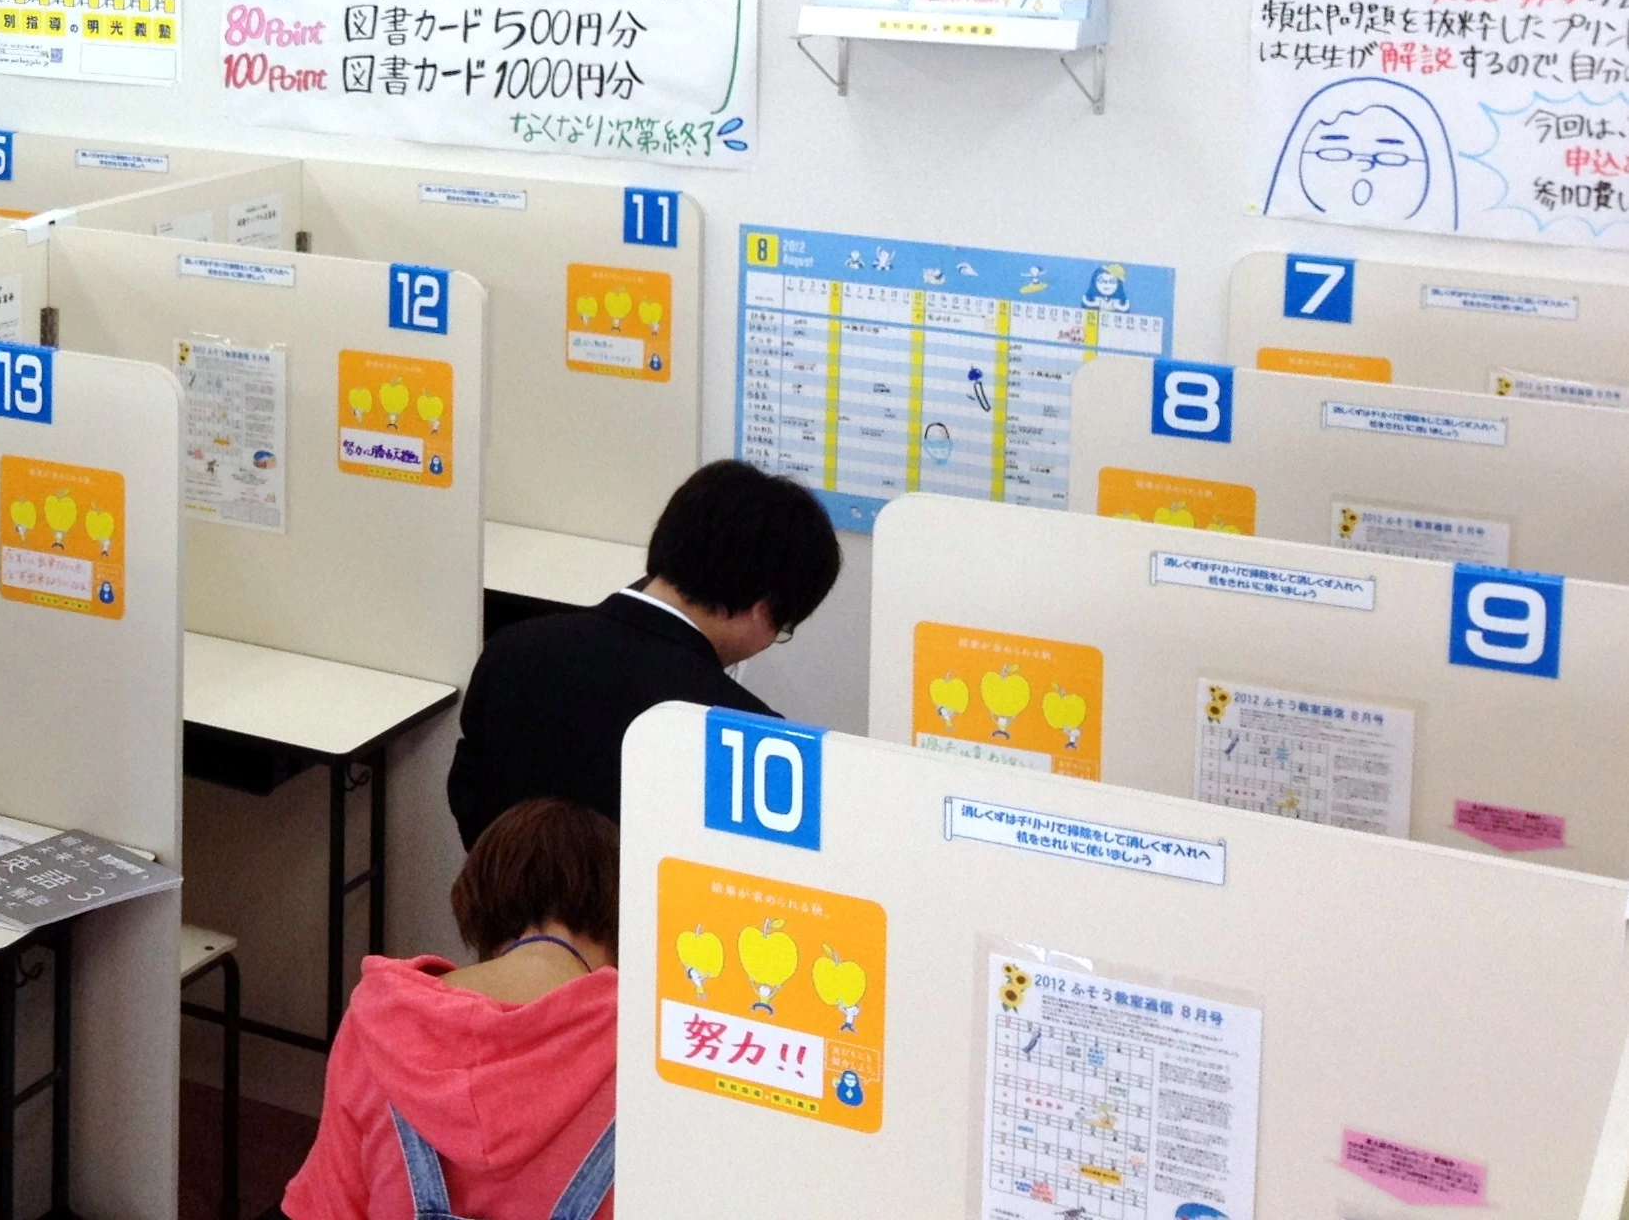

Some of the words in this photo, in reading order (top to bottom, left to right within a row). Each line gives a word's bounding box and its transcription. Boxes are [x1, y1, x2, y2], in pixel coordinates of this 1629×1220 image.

[1259, 40, 1629, 84] は先生が解説するので、自分
[510, 112, 716, 157] なくなり次第終了
[630, 193, 671, 244] 11
[757, 238, 768, 262] 8
[397, 273, 440, 328] 12
[1293, 262, 1347, 315] 7
[1162, 371, 1221, 432] 8
[1465, 583, 1547, 665] 9
[1234, 691, 1260, 706] 2012
[721, 726, 803, 833] 10
[1034, 973, 1066, 993] 2012
[1071, 981, 1174, 1017] ふそう教室通信
[1181, 1003, 1224, 1027] 8月号
[683, 1012, 807, 1079] 努力!!
